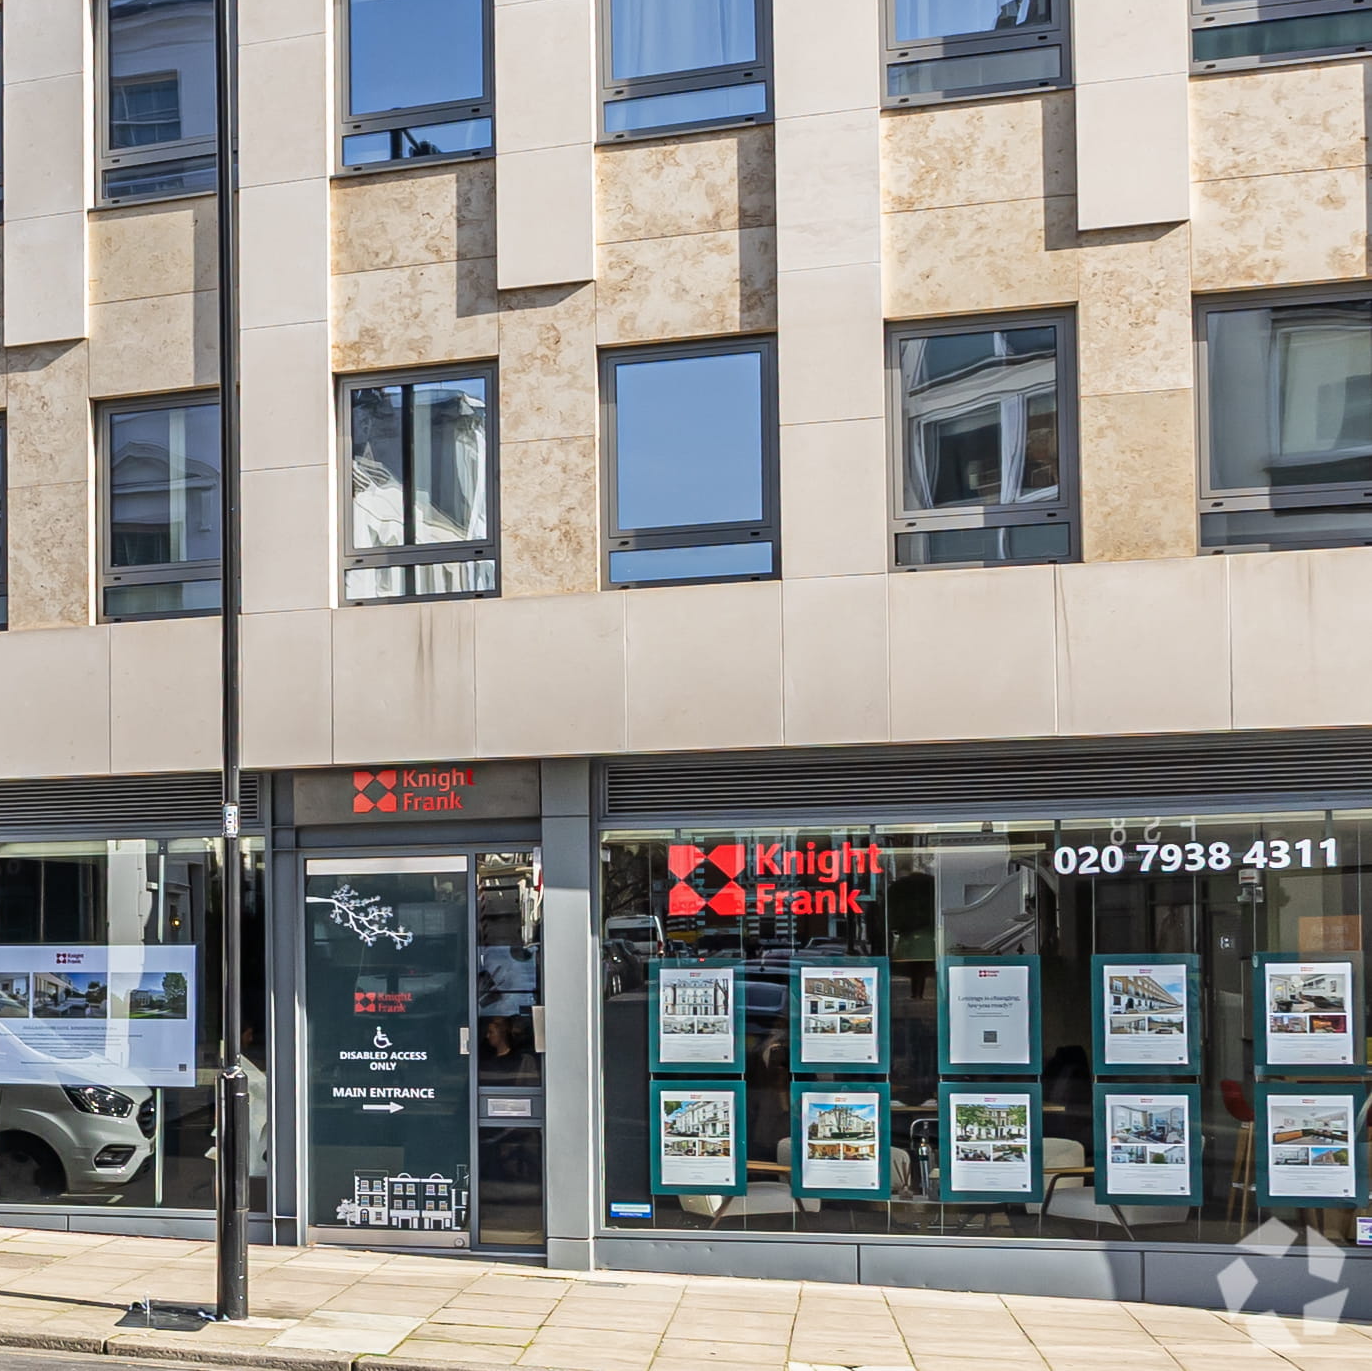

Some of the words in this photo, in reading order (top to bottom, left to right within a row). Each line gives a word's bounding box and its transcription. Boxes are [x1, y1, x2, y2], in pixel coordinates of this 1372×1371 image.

[402, 768, 475, 792] Knight
[403, 791, 463, 811] Frank
[756, 841, 884, 883] Knight
[1054, 845, 1124, 875] 020
[1135, 841, 1231, 872] 7938
[1242, 838, 1337, 869] 4311
[756, 881, 863, 915] Frank
[377, 992, 412, 1002] Knight
[378, 1003, 406, 1012] Frank
[339, 1051, 388, 1060] DISABLED
[390, 1051, 427, 1060] ACCESS
[370, 1062, 396, 1071] ONLY
[333, 1087, 366, 1098] MAIN
[369, 1088, 435, 1098] ENTRANCE
